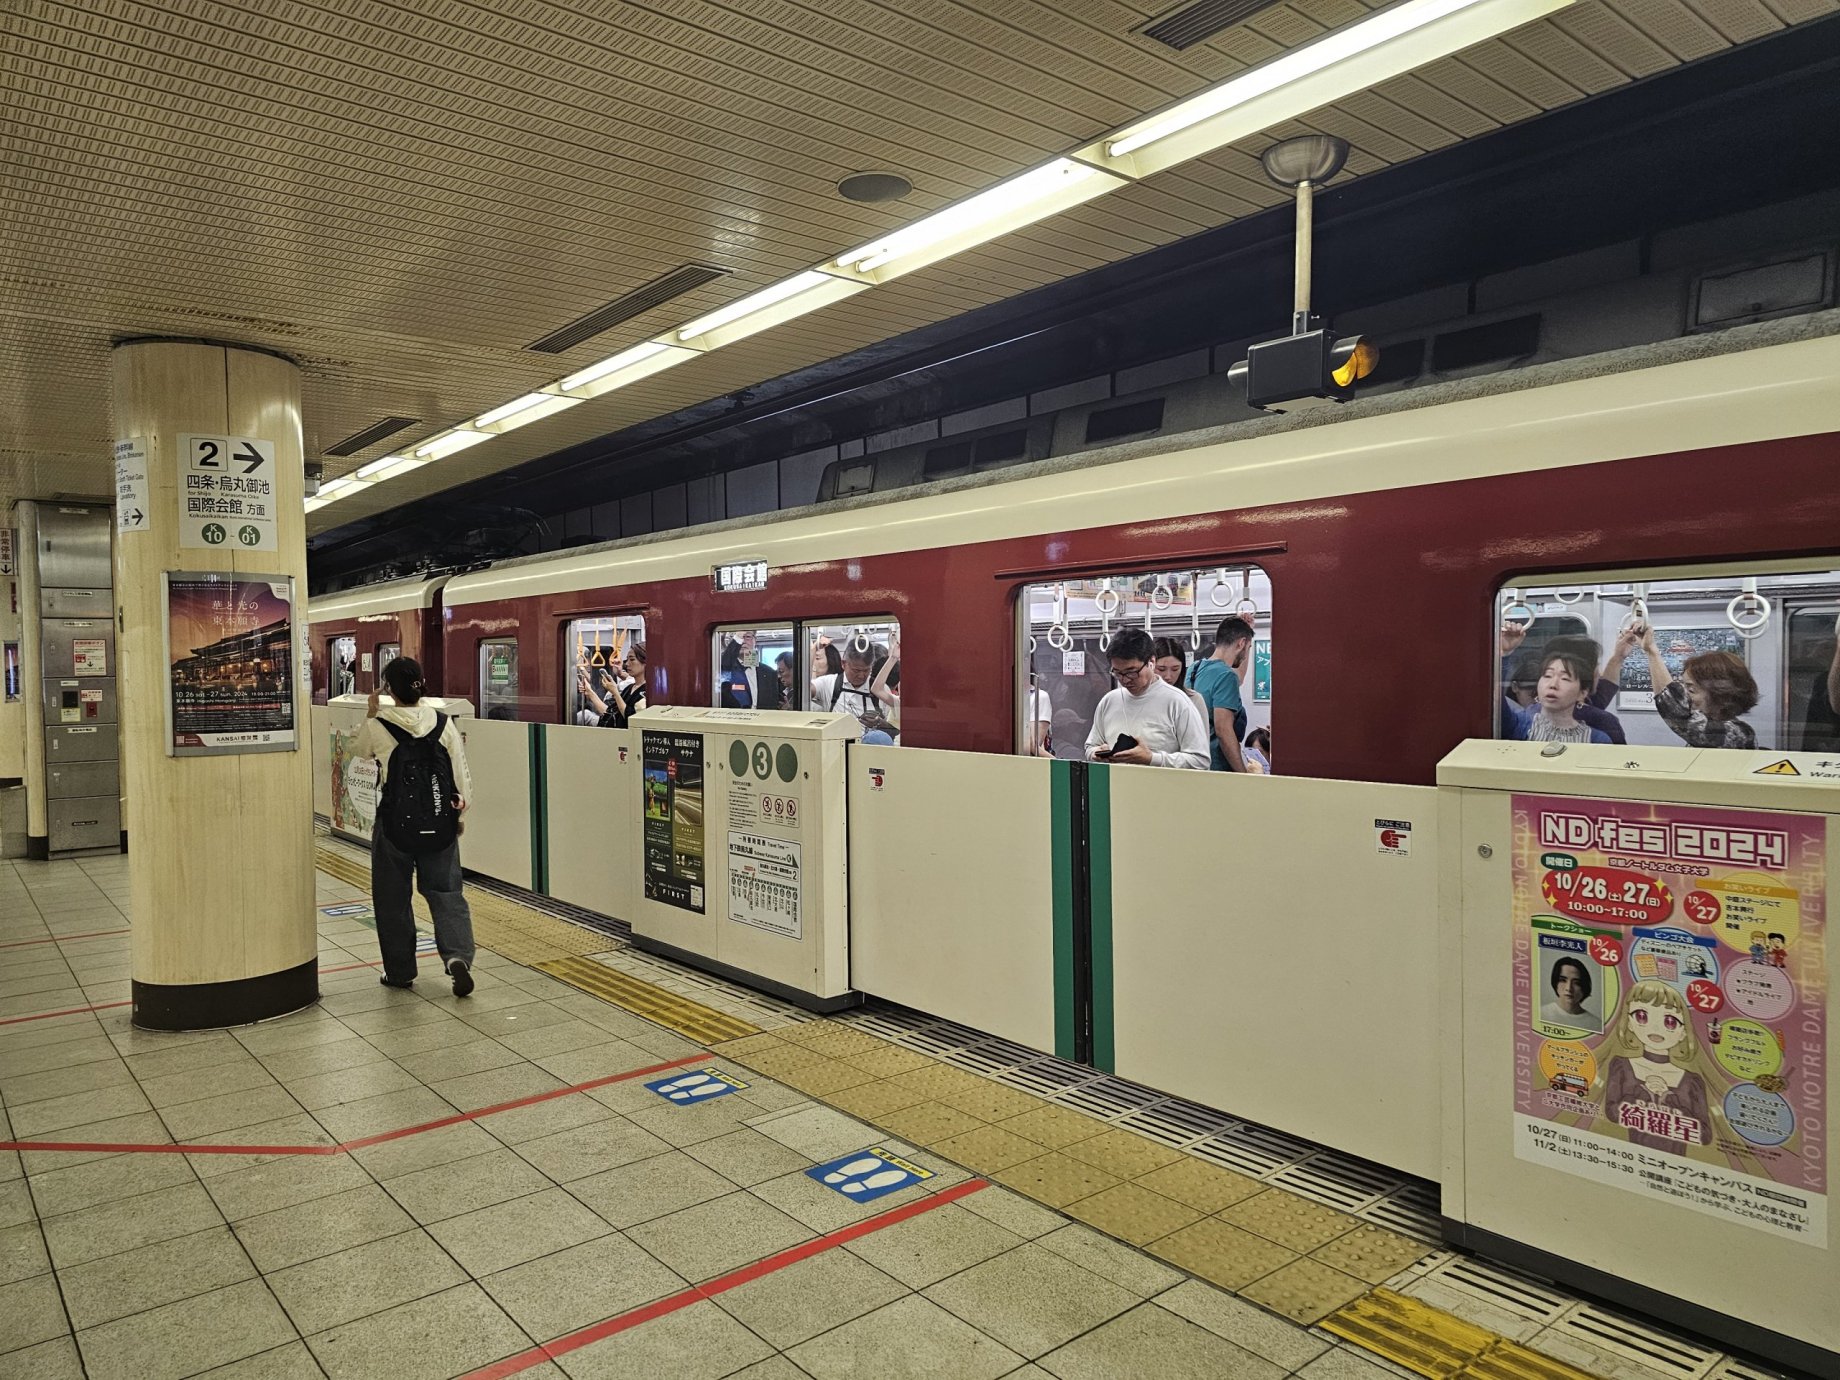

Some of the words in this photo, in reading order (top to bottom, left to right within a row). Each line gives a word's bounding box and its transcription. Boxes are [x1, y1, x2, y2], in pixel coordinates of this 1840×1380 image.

[199, 441, 219, 467] 2
[187, 474, 270, 494] 四条・烏丸御池
[187, 497, 242, 514] 国際会館
[247, 503, 265, 516] 方面
[205, 531, 223, 543] 10
[209, 524, 218, 532] K
[246, 526, 253, 534] K
[241, 533, 256, 545] 01
[756, 746, 769, 776] 3
[1543, 815, 1591, 847] ND
[1598, 818, 1665, 857] fes
[1674, 826, 1784, 865] 2024
[1545, 856, 1574, 868] 開催日
[1607, 857, 1710, 877] 京都ノートルダム女子大学
[792, 870, 797, 880] 2
[662, 888, 685, 900] FIRST
[1550, 923, 1592, 934] トークショー
[1654, 931, 1695, 944] ビンゴ大会
[1515, 995, 1533, 1111] UNIVERSITY
[1802, 1042, 1821, 1111] NOTRE
[1619, 1102, 1702, 1146] 綺羅星
[1802, 1117, 1822, 1188] KYOTO
[1636, 1153, 1754, 1195] ミニオープンキャンパス
